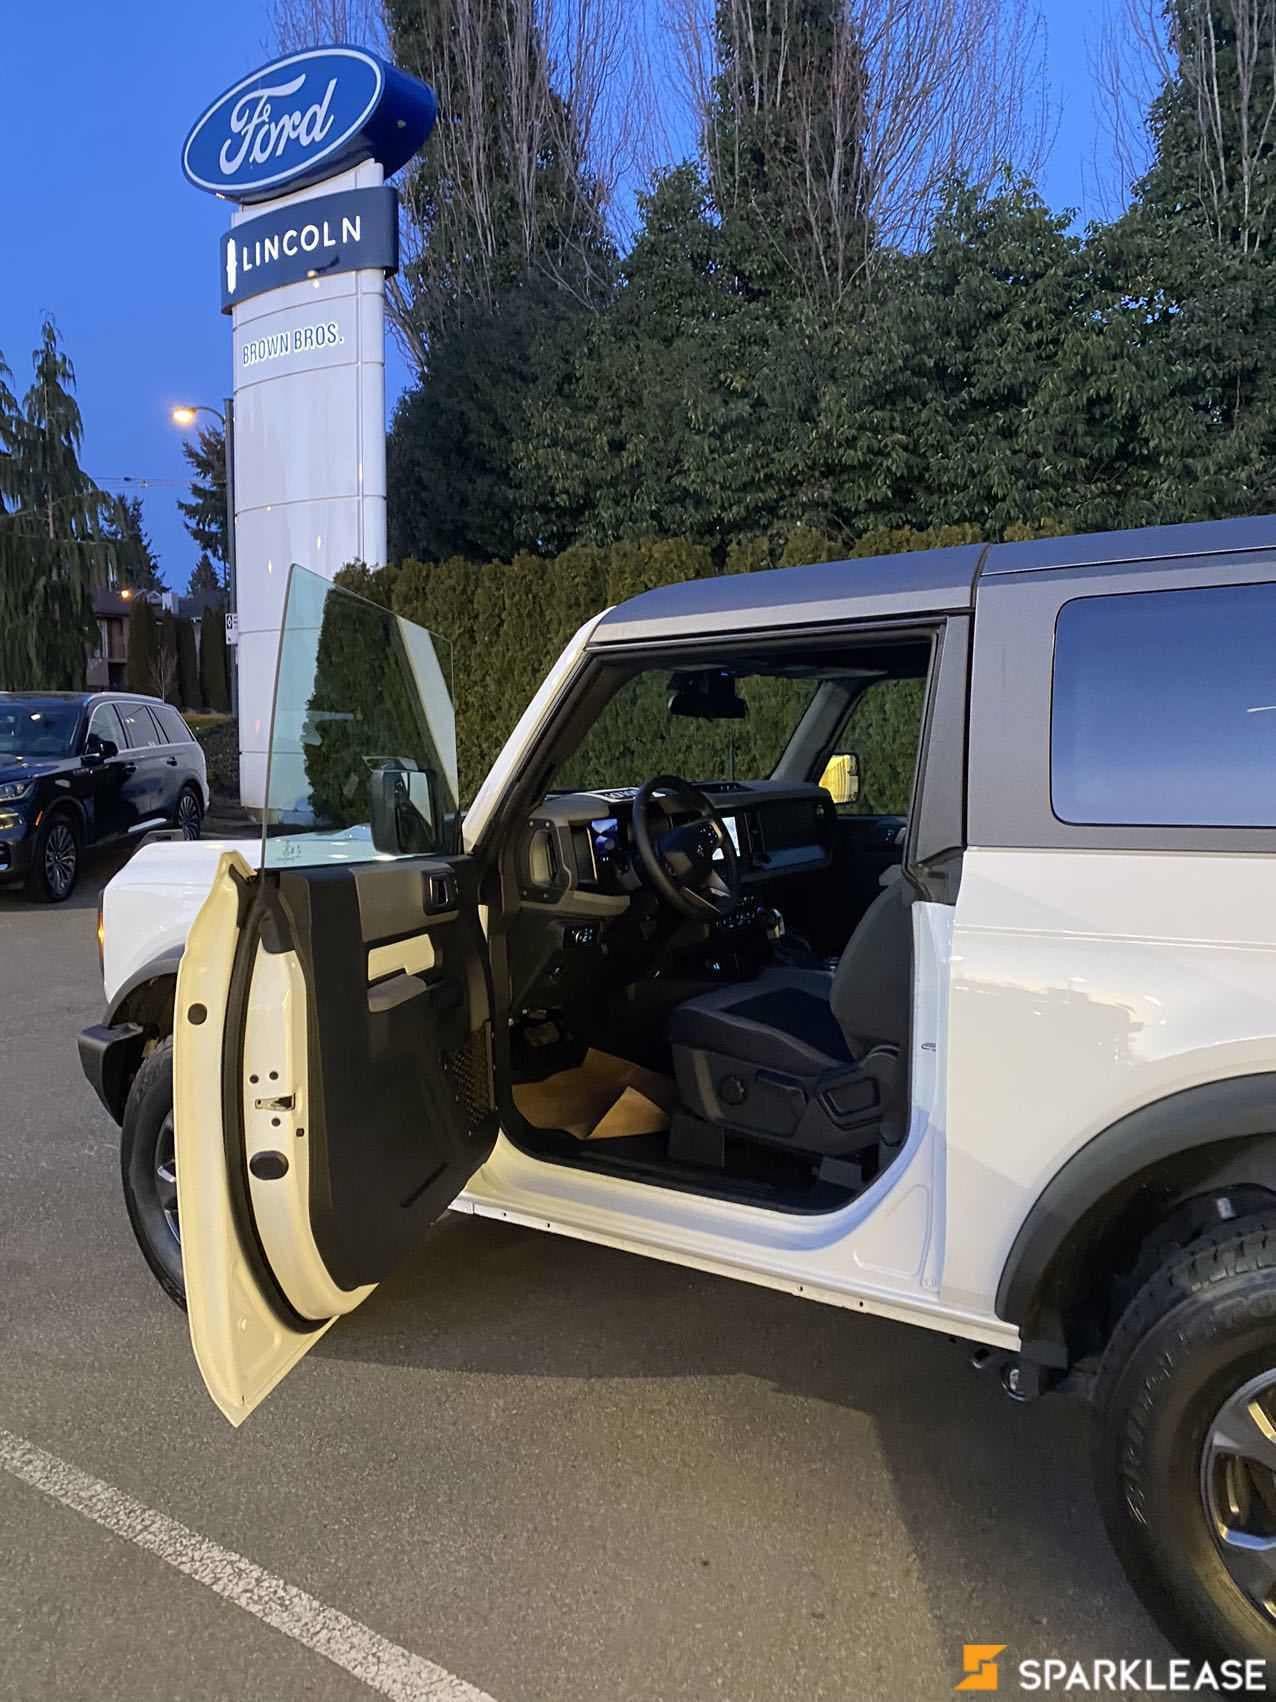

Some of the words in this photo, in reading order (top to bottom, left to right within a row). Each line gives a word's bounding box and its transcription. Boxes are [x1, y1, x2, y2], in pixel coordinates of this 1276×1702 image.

[219, 73, 338, 175] Ford
[242, 215, 361, 272] LINCOLN
[242, 332, 290, 366] BROWN
[294, 322, 343, 351] BROS.
